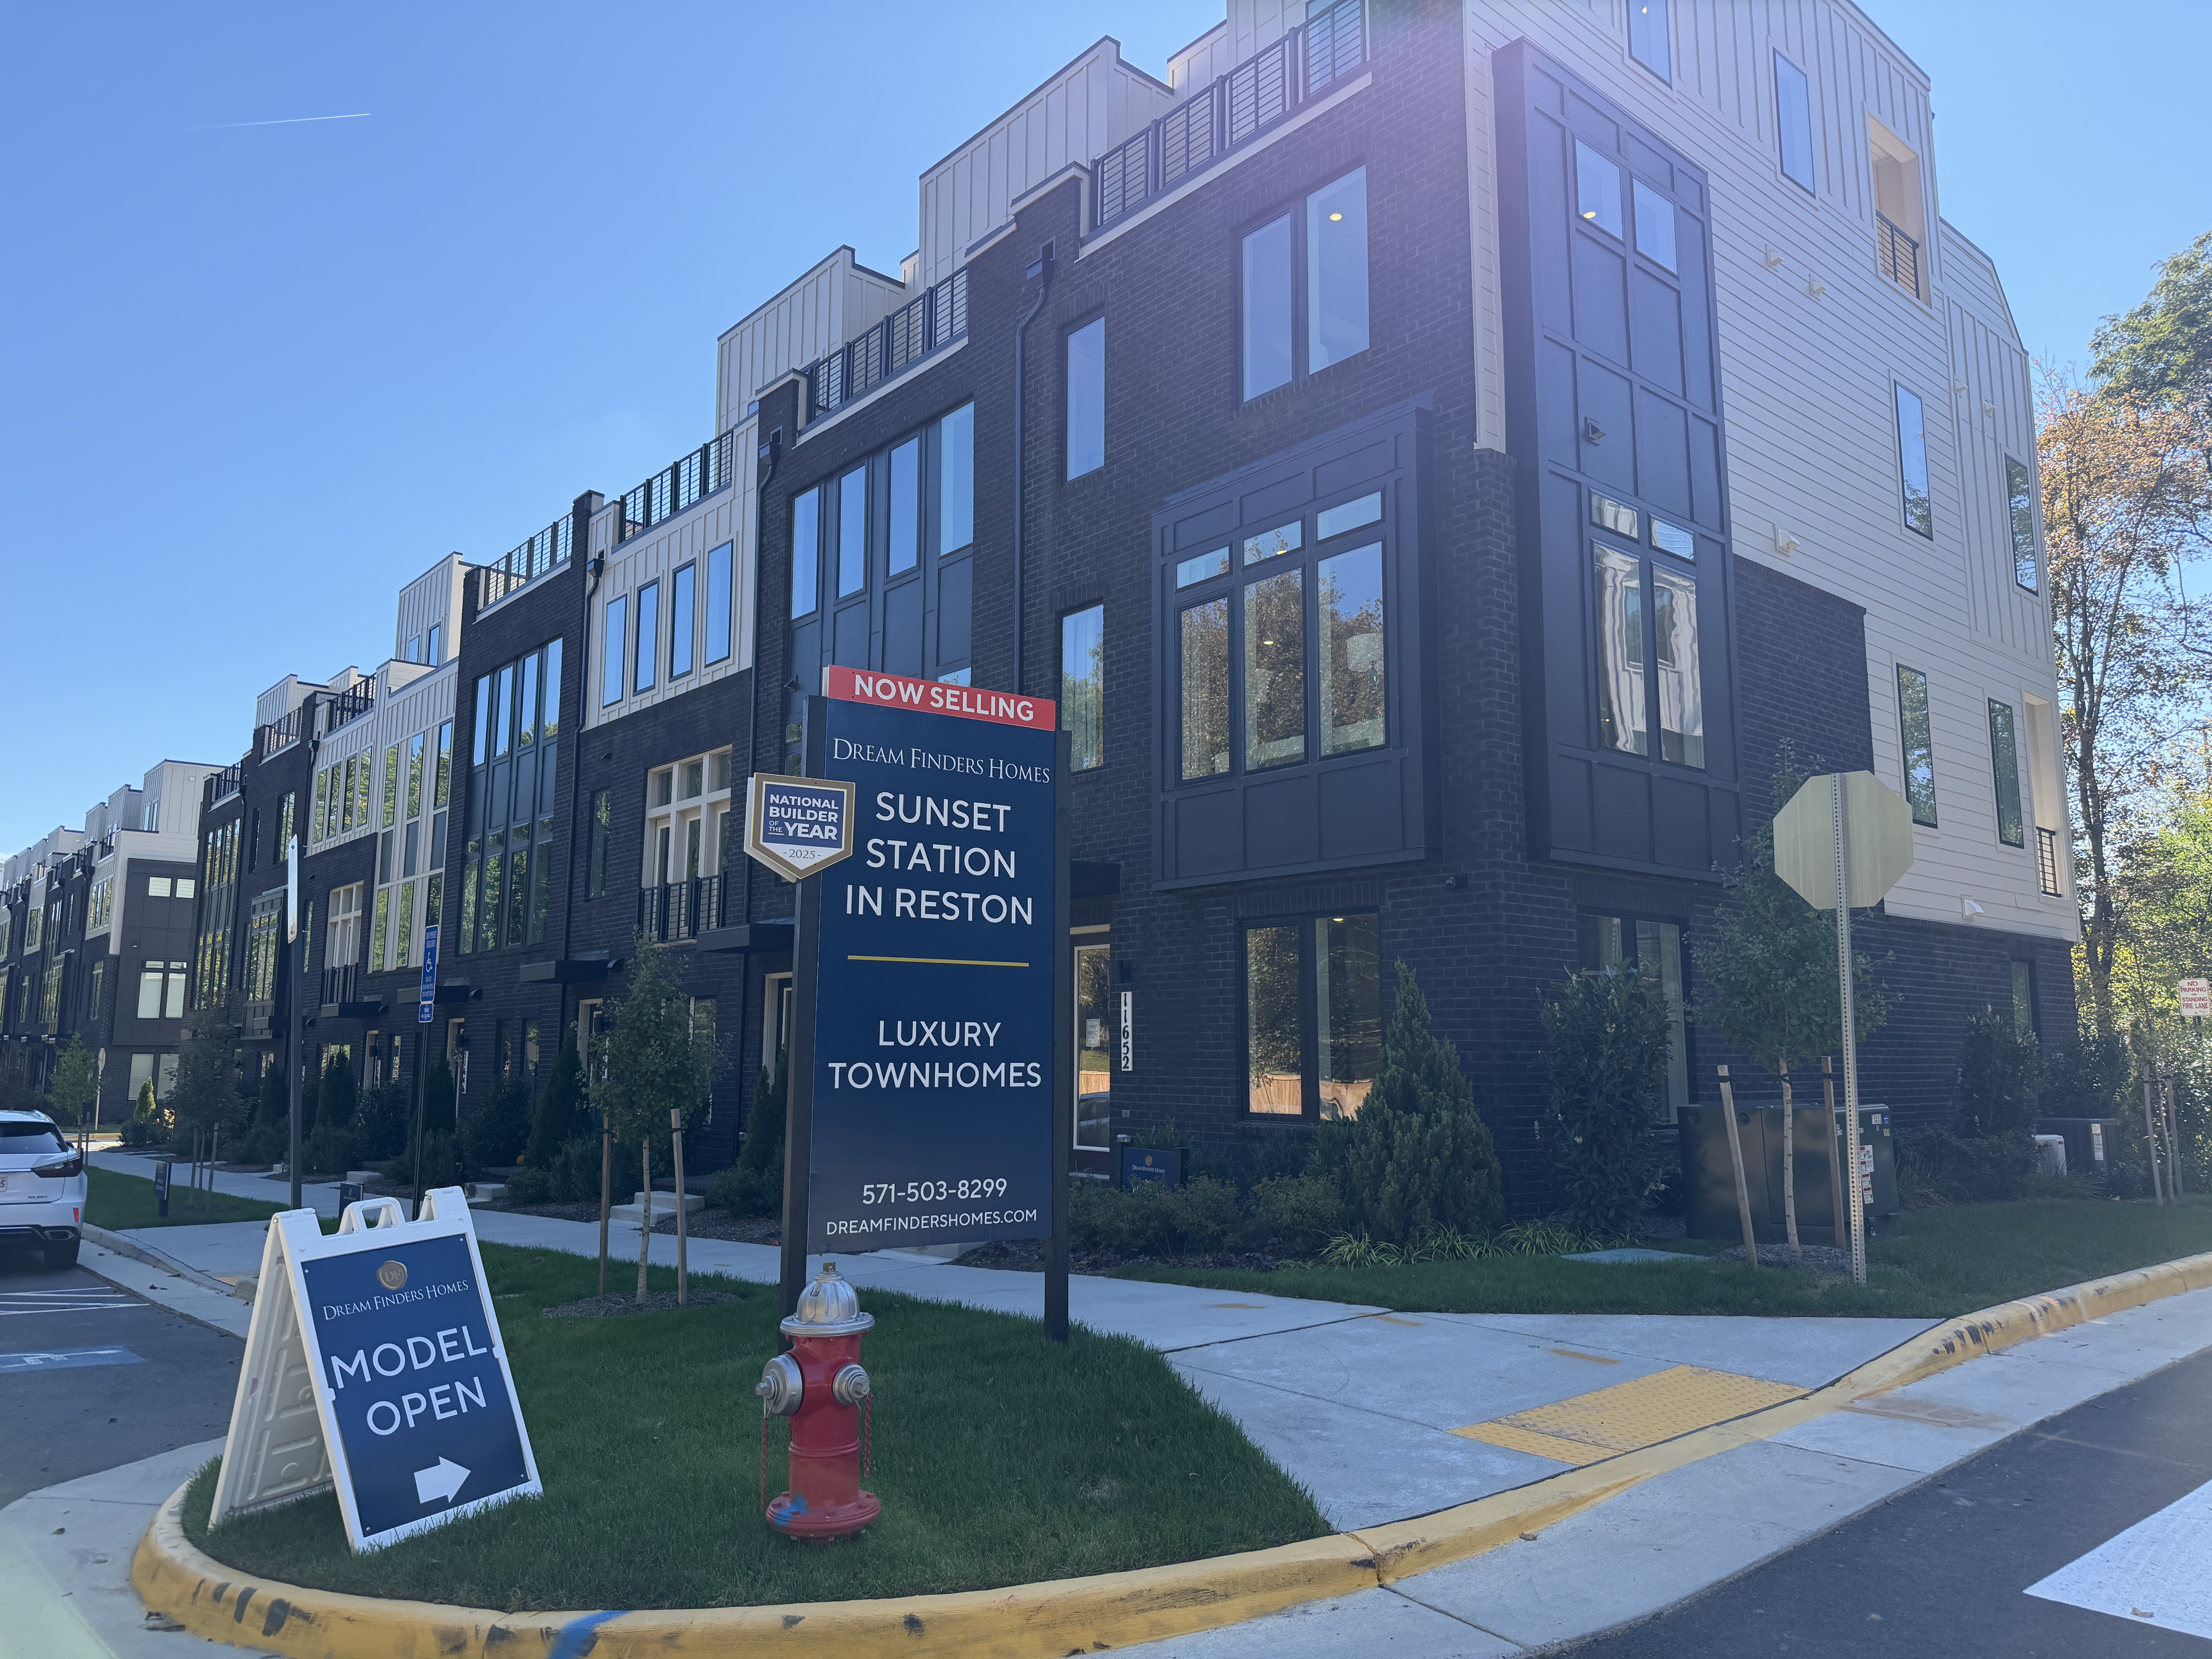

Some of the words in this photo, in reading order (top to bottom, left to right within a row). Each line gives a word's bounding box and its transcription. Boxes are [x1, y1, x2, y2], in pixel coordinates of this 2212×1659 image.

[855, 675, 924, 704] NOW
[930, 686, 1034, 721] SELLING
[833, 738, 904, 766] DREAM
[910, 748, 984, 775] FINDERS
[989, 758, 1050, 783] HOMES
[769, 806, 838, 823] BUILDER
[770, 794, 838, 809] NATIONAL
[876, 792, 1011, 832] SUNSET
[784, 822, 837, 840] YEAR
[866, 838, 1015, 878] STATION
[847, 884, 882, 916] IN
[896, 888, 1032, 925] RESTON
[879, 1020, 1001, 1046] LUXURY
[828, 1062, 1042, 1089] TOWNHOMES
[862, 1178, 1007, 1204] 571-503-8299
[826, 1209, 1037, 1235] DREAMFINDERSHOMES.COM
[385, 1269, 401, 1281] DF
[323, 1300, 371, 1320] DREAM
[373, 1289, 424, 1310] FINDERS
[426, 1280, 469, 1299] HOMES
[331, 1326, 488, 1389] MODEL
[367, 1376, 487, 1436] OPEN
